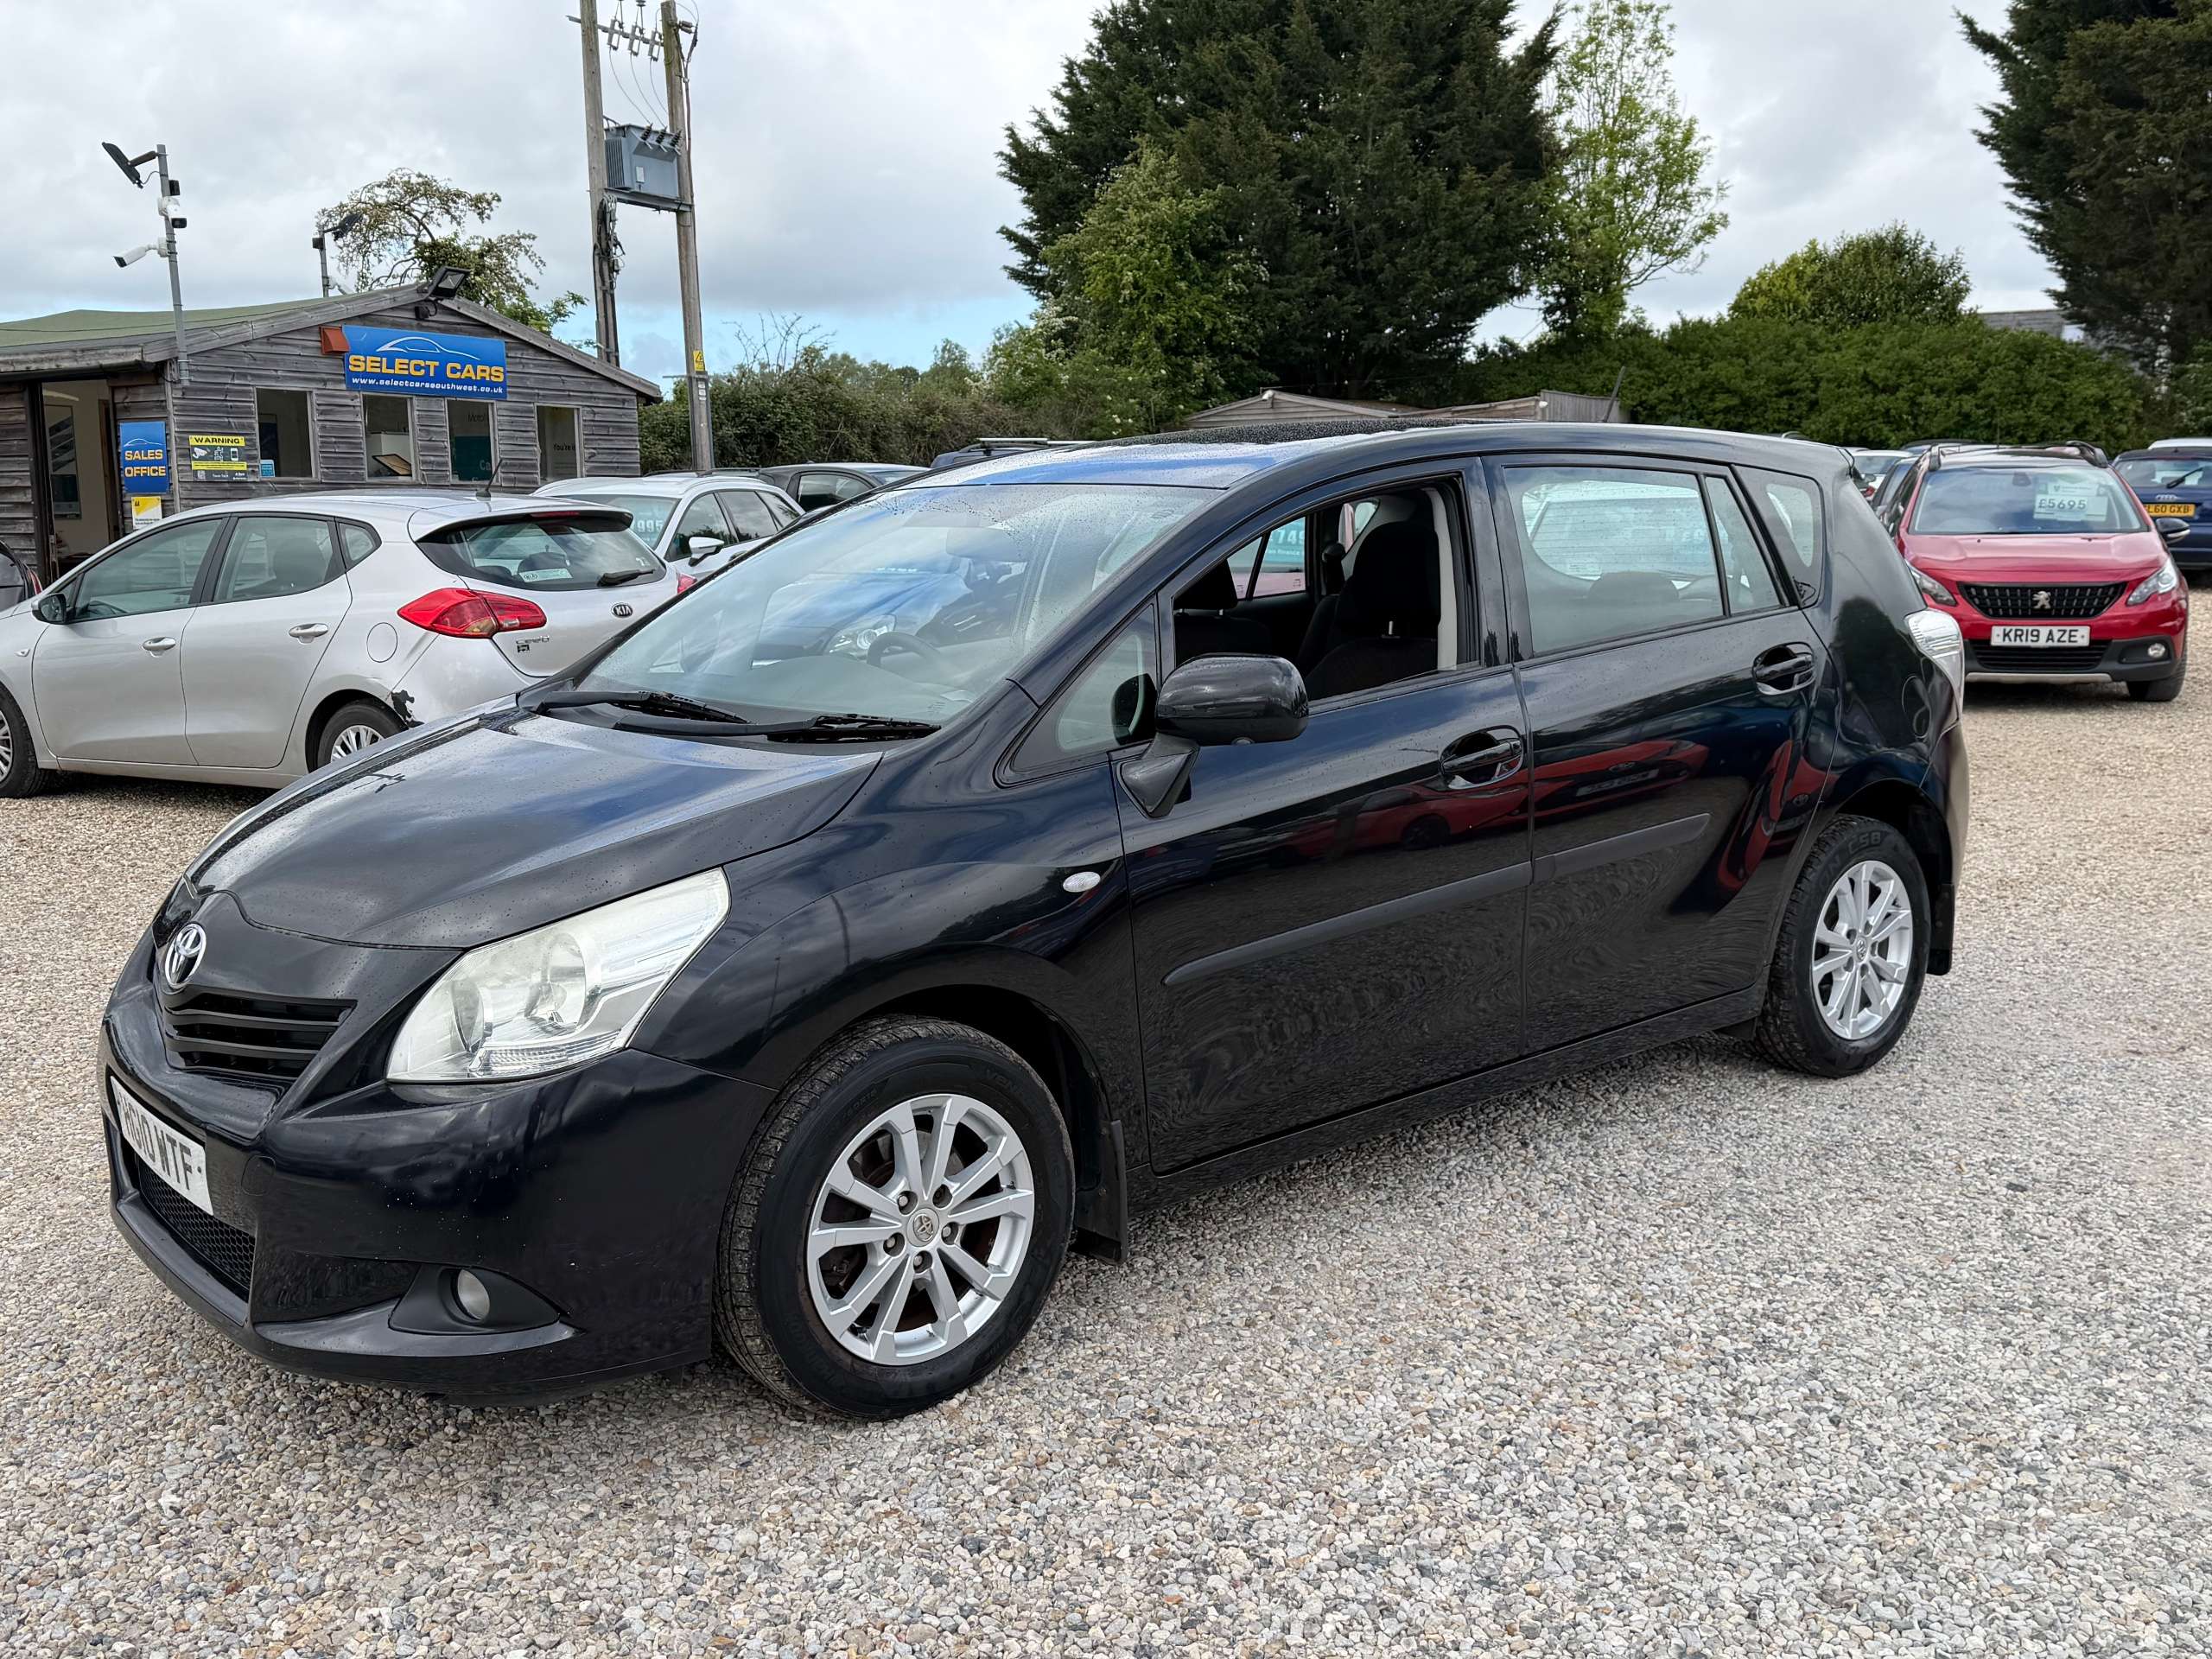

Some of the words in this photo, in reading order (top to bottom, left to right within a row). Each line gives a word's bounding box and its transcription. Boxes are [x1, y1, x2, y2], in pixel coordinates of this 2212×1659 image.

[348, 354, 440, 377] SELECT
[445, 362, 505, 383] CARS
[352, 377, 504, 393] www.selectcarssouthwest.co.uk
[124, 448, 163, 461] SALES
[124, 466, 167, 477] OFFICE
[2038, 499, 2087, 510] £5695
[2143, 505, 2167, 513] L60
[614, 604, 632, 615] KIA
[2002, 628, 2041, 643] KR19
[2045, 629, 2079, 644] AZE
[154, 1124, 193, 1192] WTF
